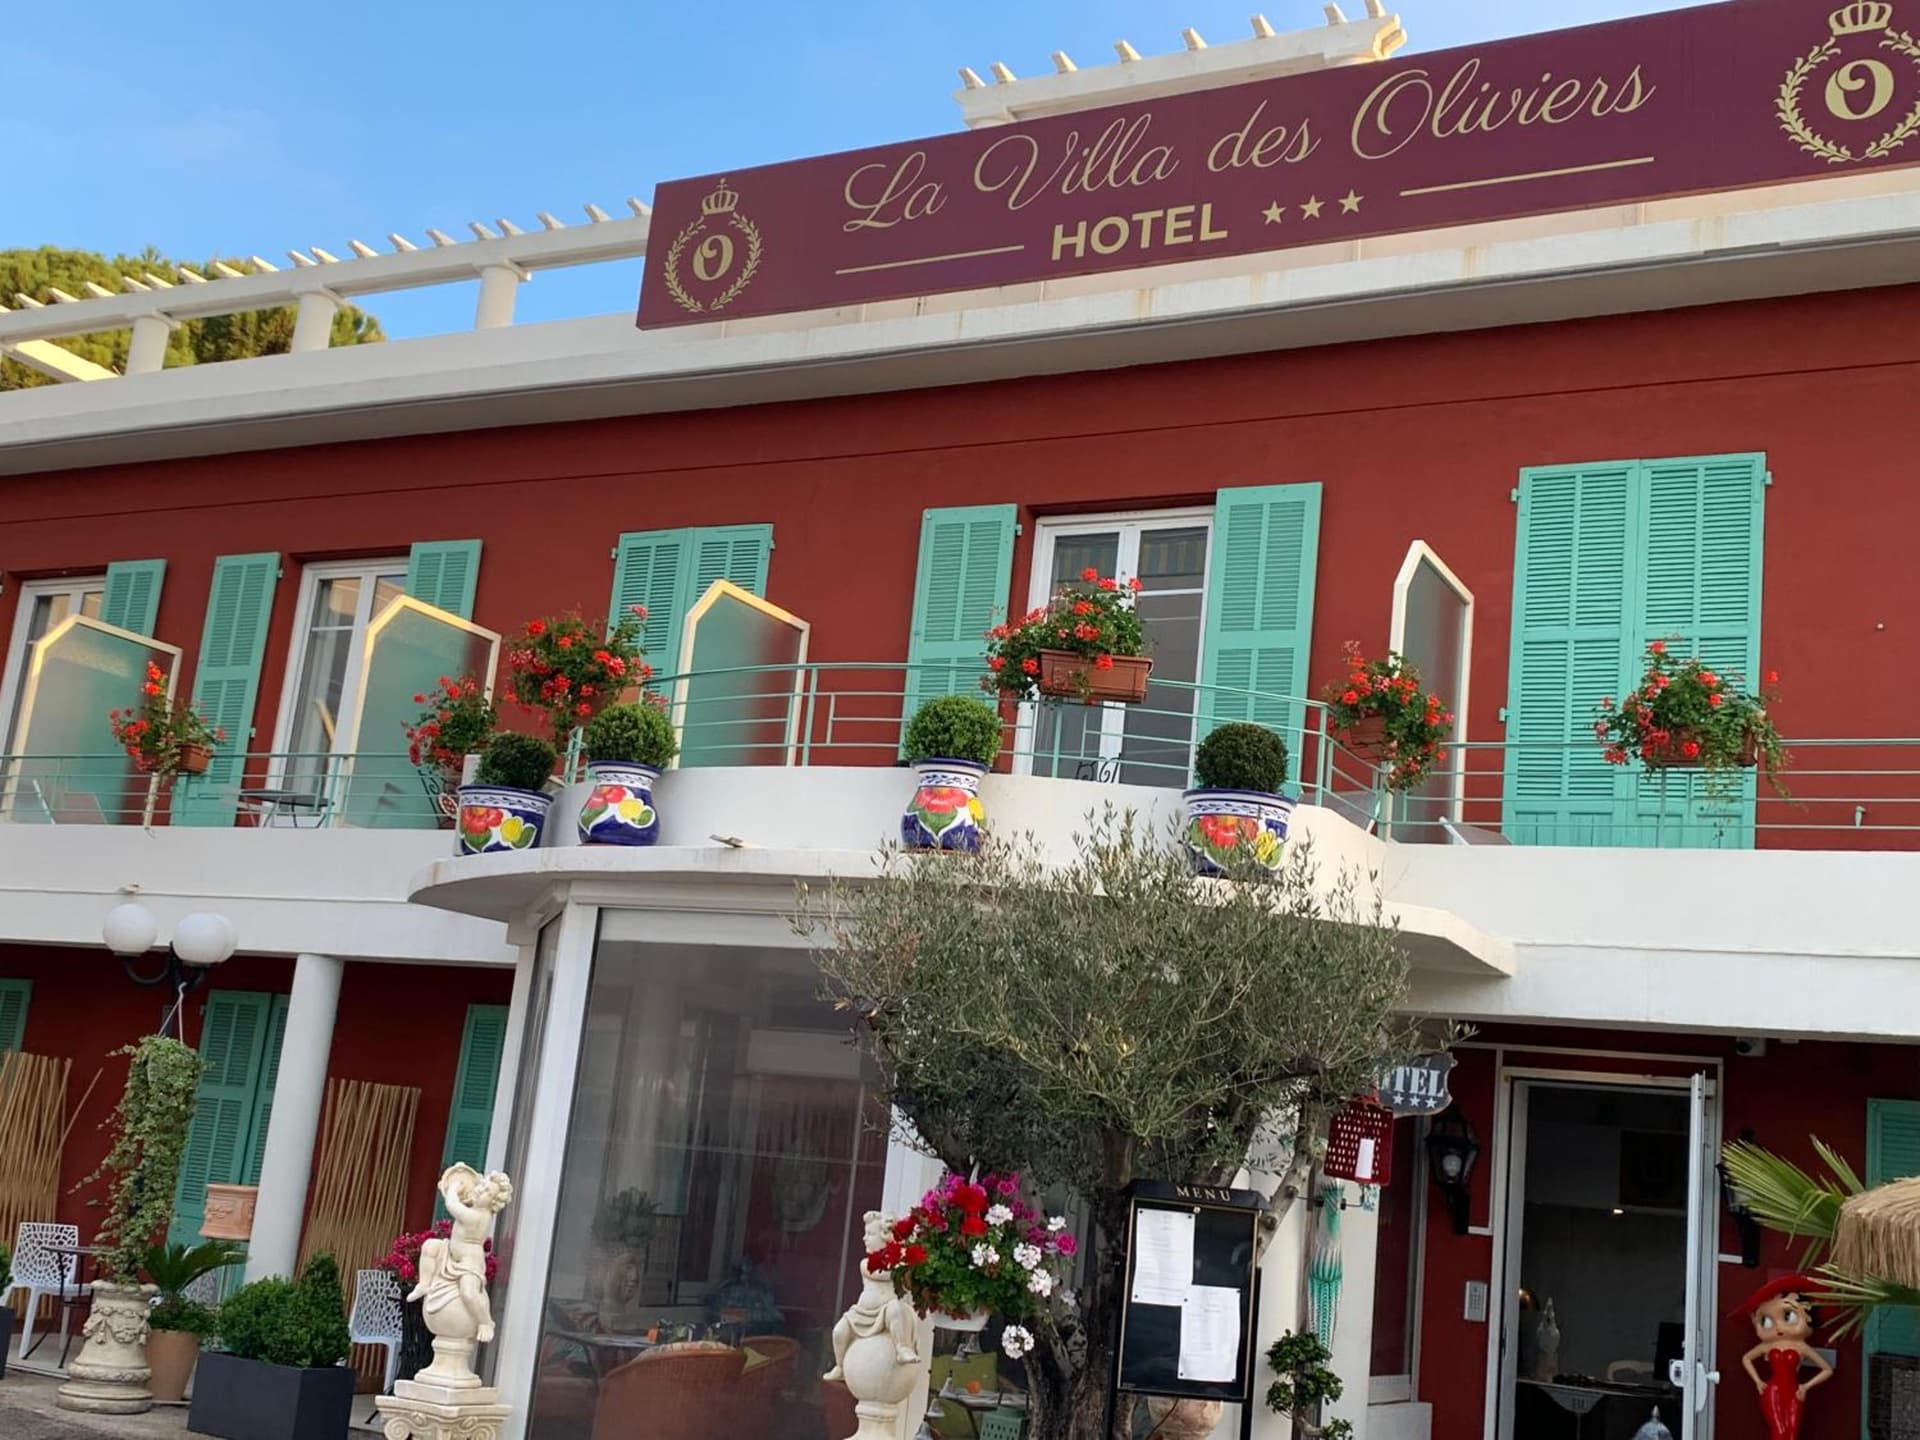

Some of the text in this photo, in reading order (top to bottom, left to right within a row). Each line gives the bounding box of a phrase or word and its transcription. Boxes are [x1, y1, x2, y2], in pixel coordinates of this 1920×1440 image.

[843, 58, 1656, 231] La Villa des Oliviers
[1051, 204, 1228, 260] HOTEL
[1176, 1185, 1231, 1201] MENU
